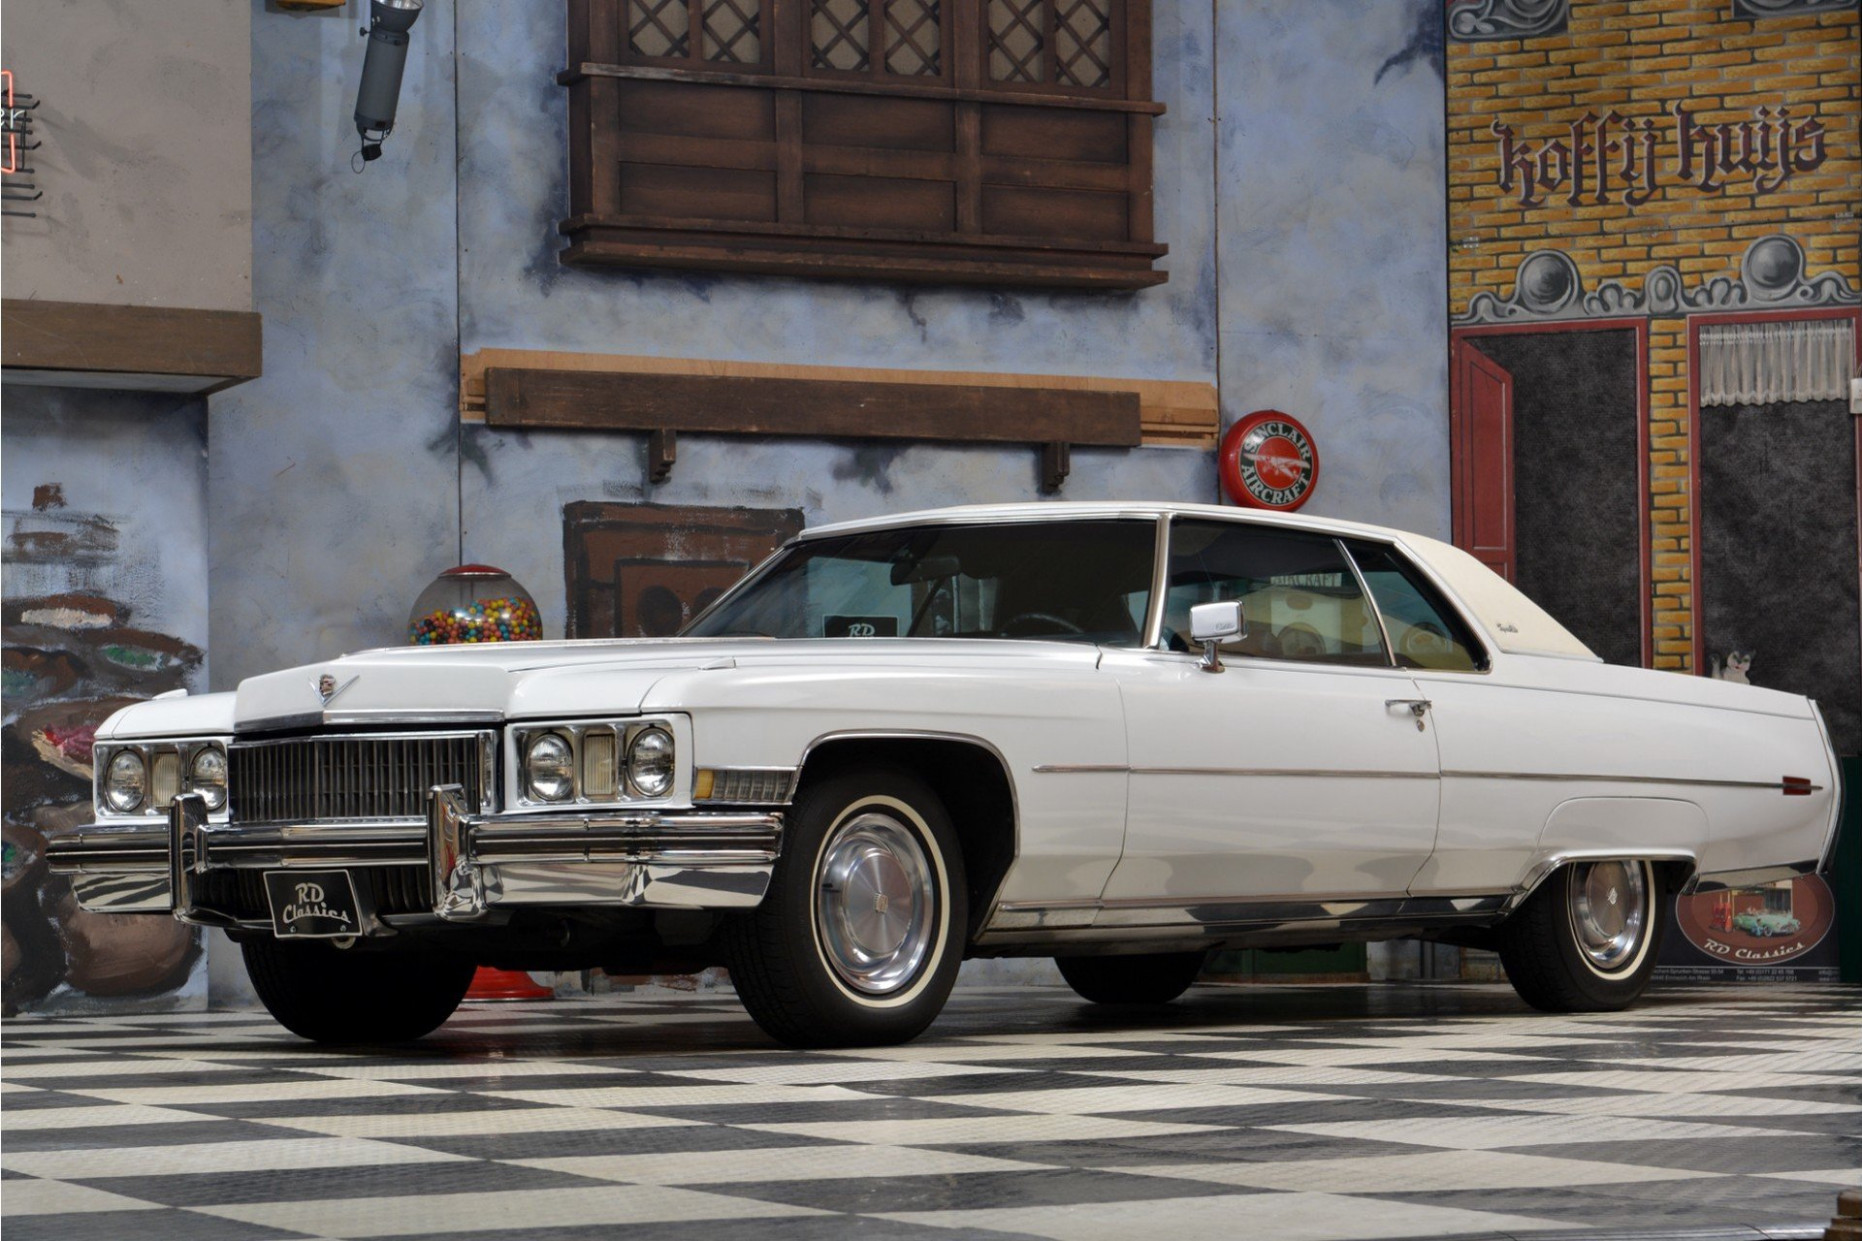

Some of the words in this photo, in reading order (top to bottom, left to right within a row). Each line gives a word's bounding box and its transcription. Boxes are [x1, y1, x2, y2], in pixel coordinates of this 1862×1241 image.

[1243, 423, 1311, 459] SNCLAIR
[1241, 464, 1310, 504] AIRCRAFT
[848, 623, 876, 637] RD
[295, 882, 325, 905] RD
[282, 902, 352, 924] Classics
[1704, 938, 1731, 955] RD
[1735, 941, 1806, 959] Classics
